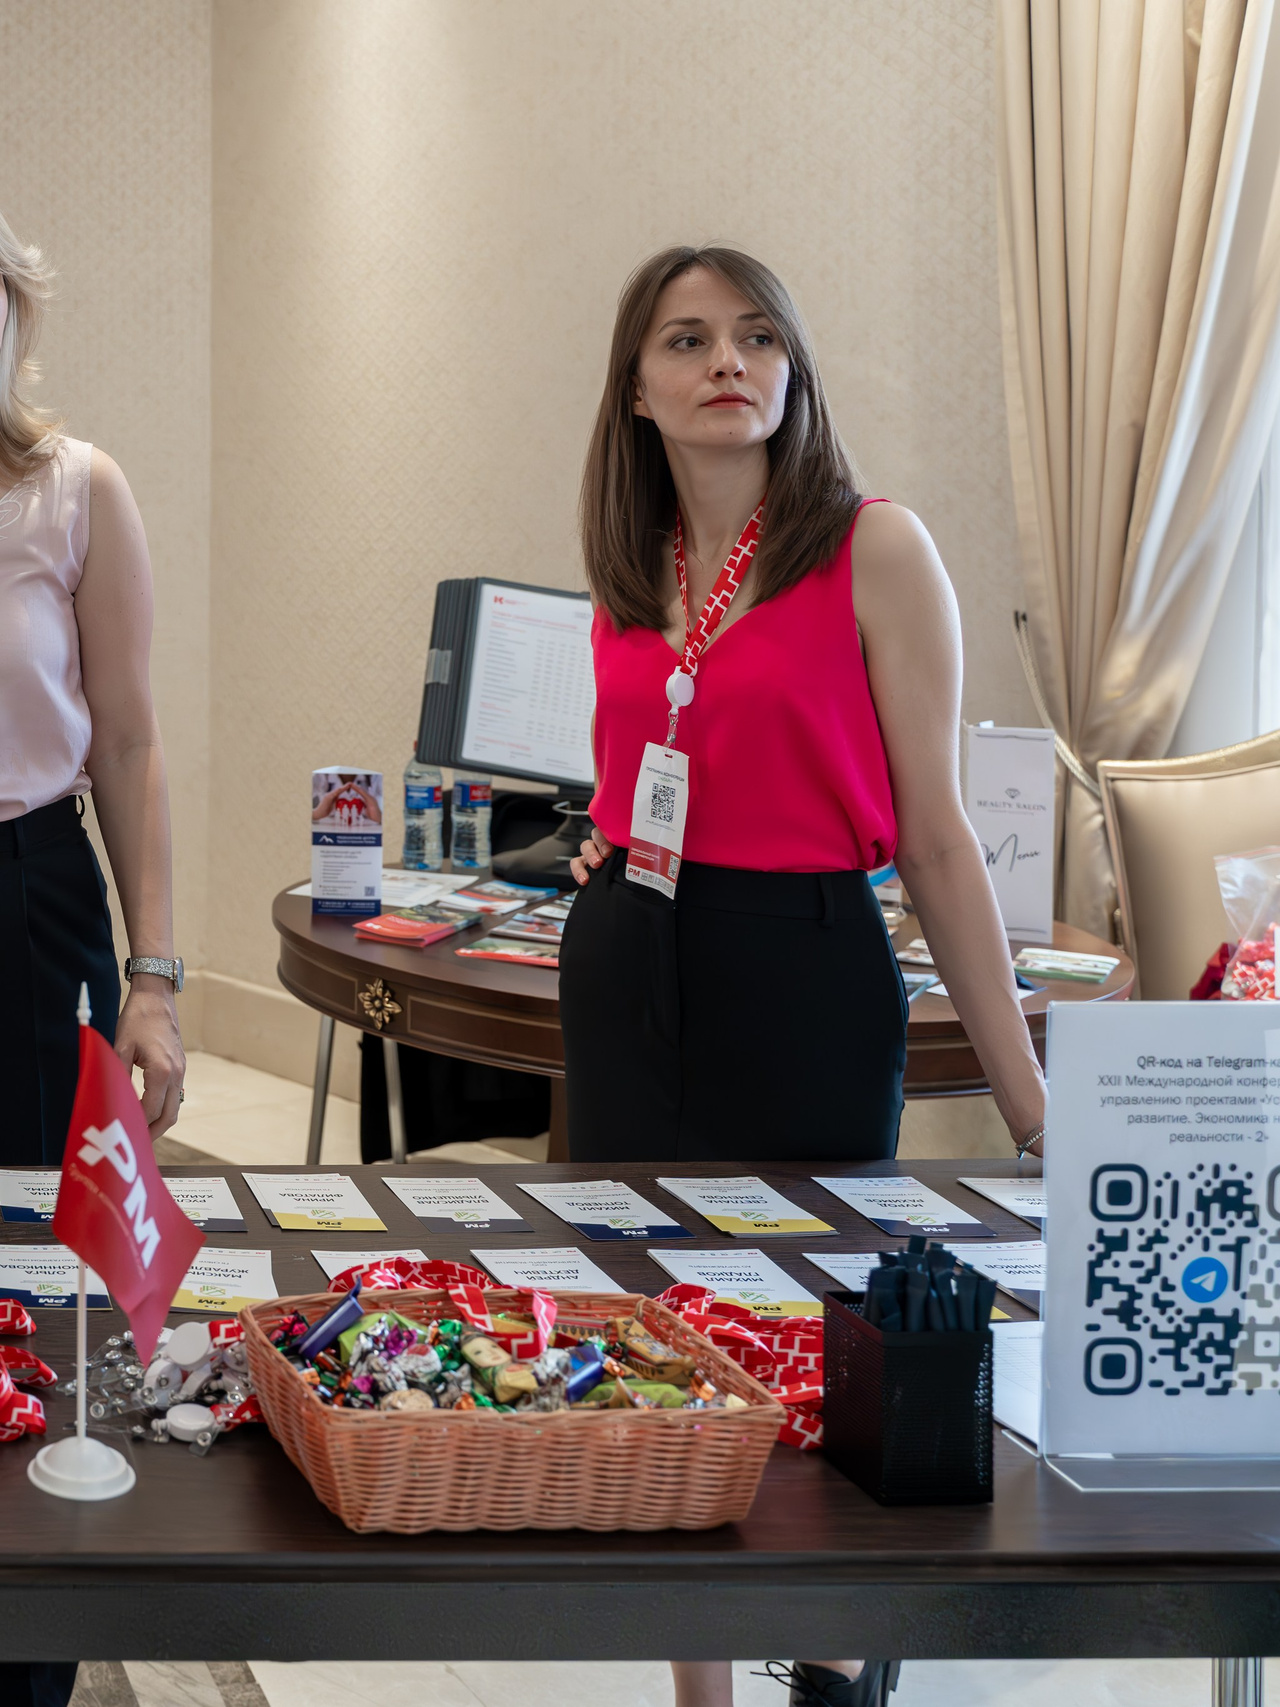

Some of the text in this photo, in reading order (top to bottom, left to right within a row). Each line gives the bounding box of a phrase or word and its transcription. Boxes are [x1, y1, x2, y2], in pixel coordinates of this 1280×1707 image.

[976, 800, 1047, 812] BEAUTY SALON
[1136, 1056, 1182, 1068] QR-код
[1186, 1059, 1202, 1068] на
[1097, 1075, 1121, 1086] XXII
[1126, 1074, 1233, 1088] Международной
[1100, 1095, 1182, 1108] управлению
[1186, 1095, 1256, 1106] проектами
[1127, 1114, 1192, 1126] развитие.
[1195, 1112, 1269, 1124] Экономика
[1169, 1132, 1244, 1144] реальности
